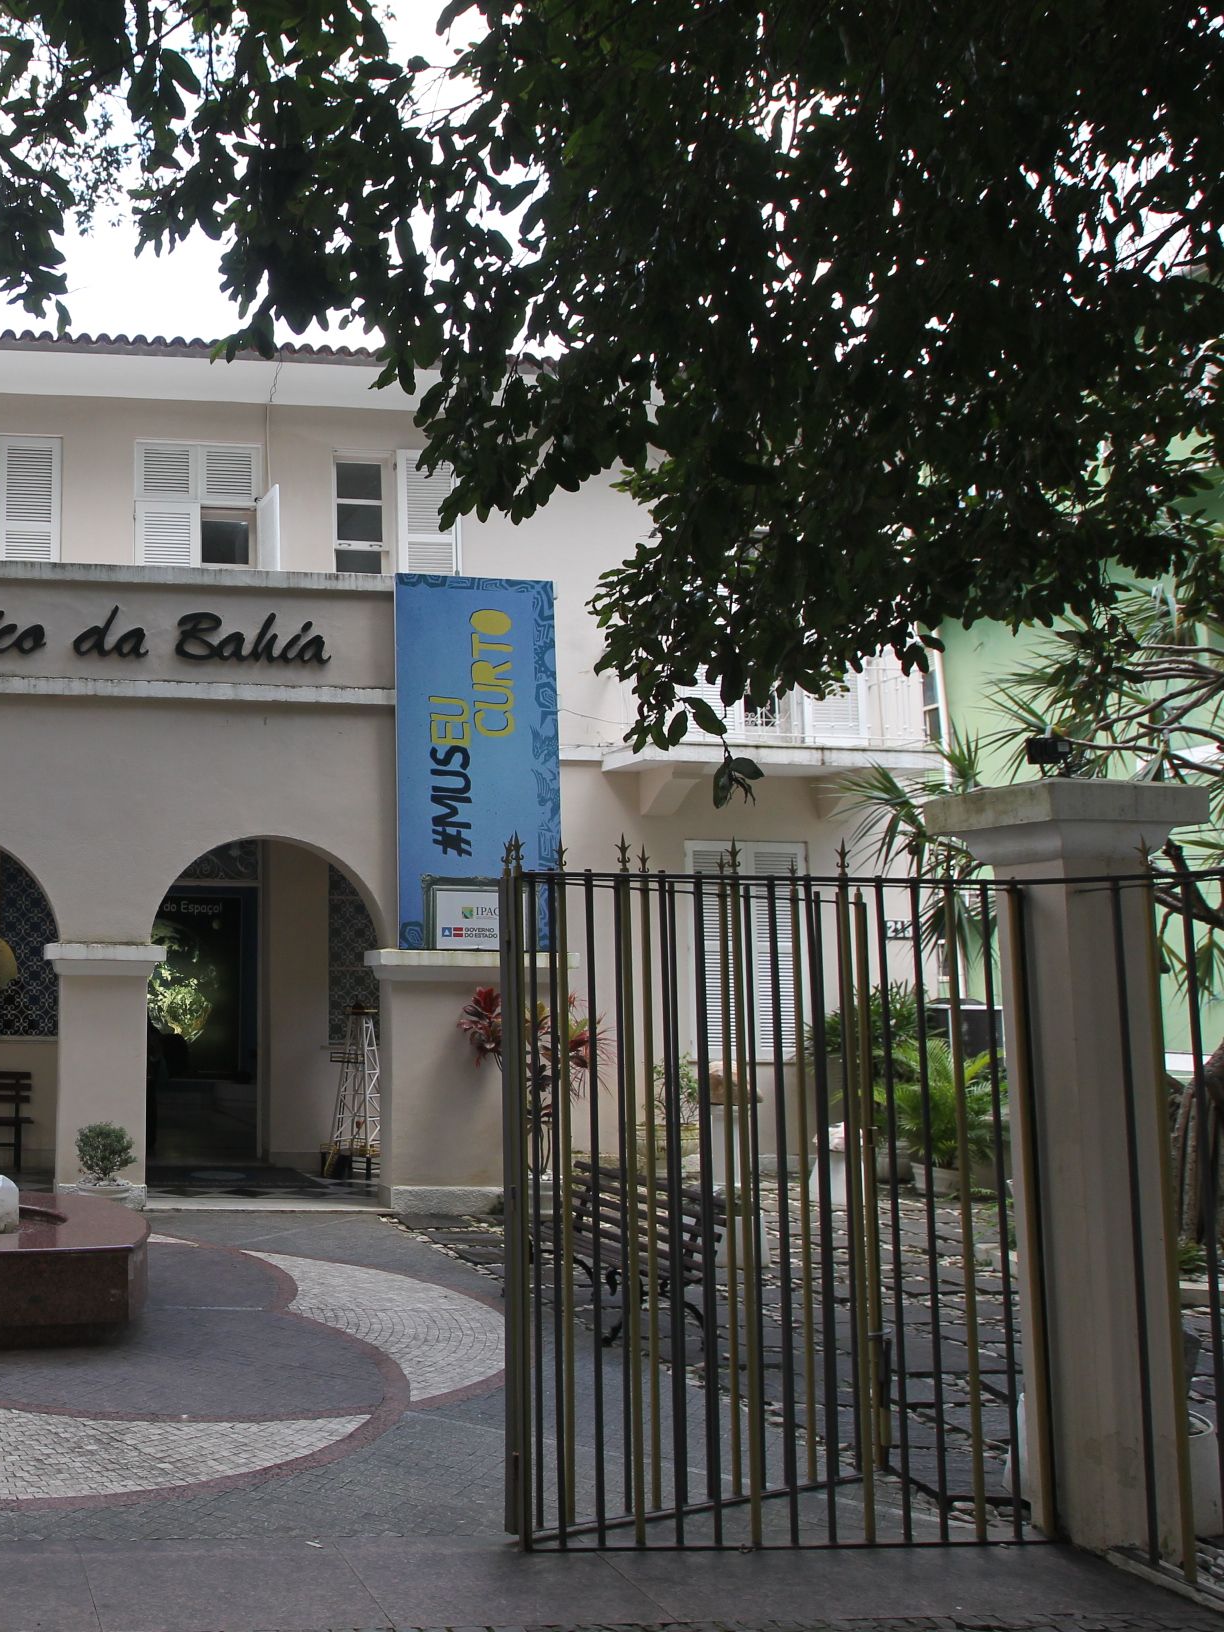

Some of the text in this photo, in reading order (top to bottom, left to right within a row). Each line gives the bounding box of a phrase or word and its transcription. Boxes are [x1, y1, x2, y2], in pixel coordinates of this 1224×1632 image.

[73, 605, 149, 663] da
[174, 611, 332, 670] Bahia
[468, 608, 515, 738] CURTO
[428, 696, 472, 858] #MUSEU
